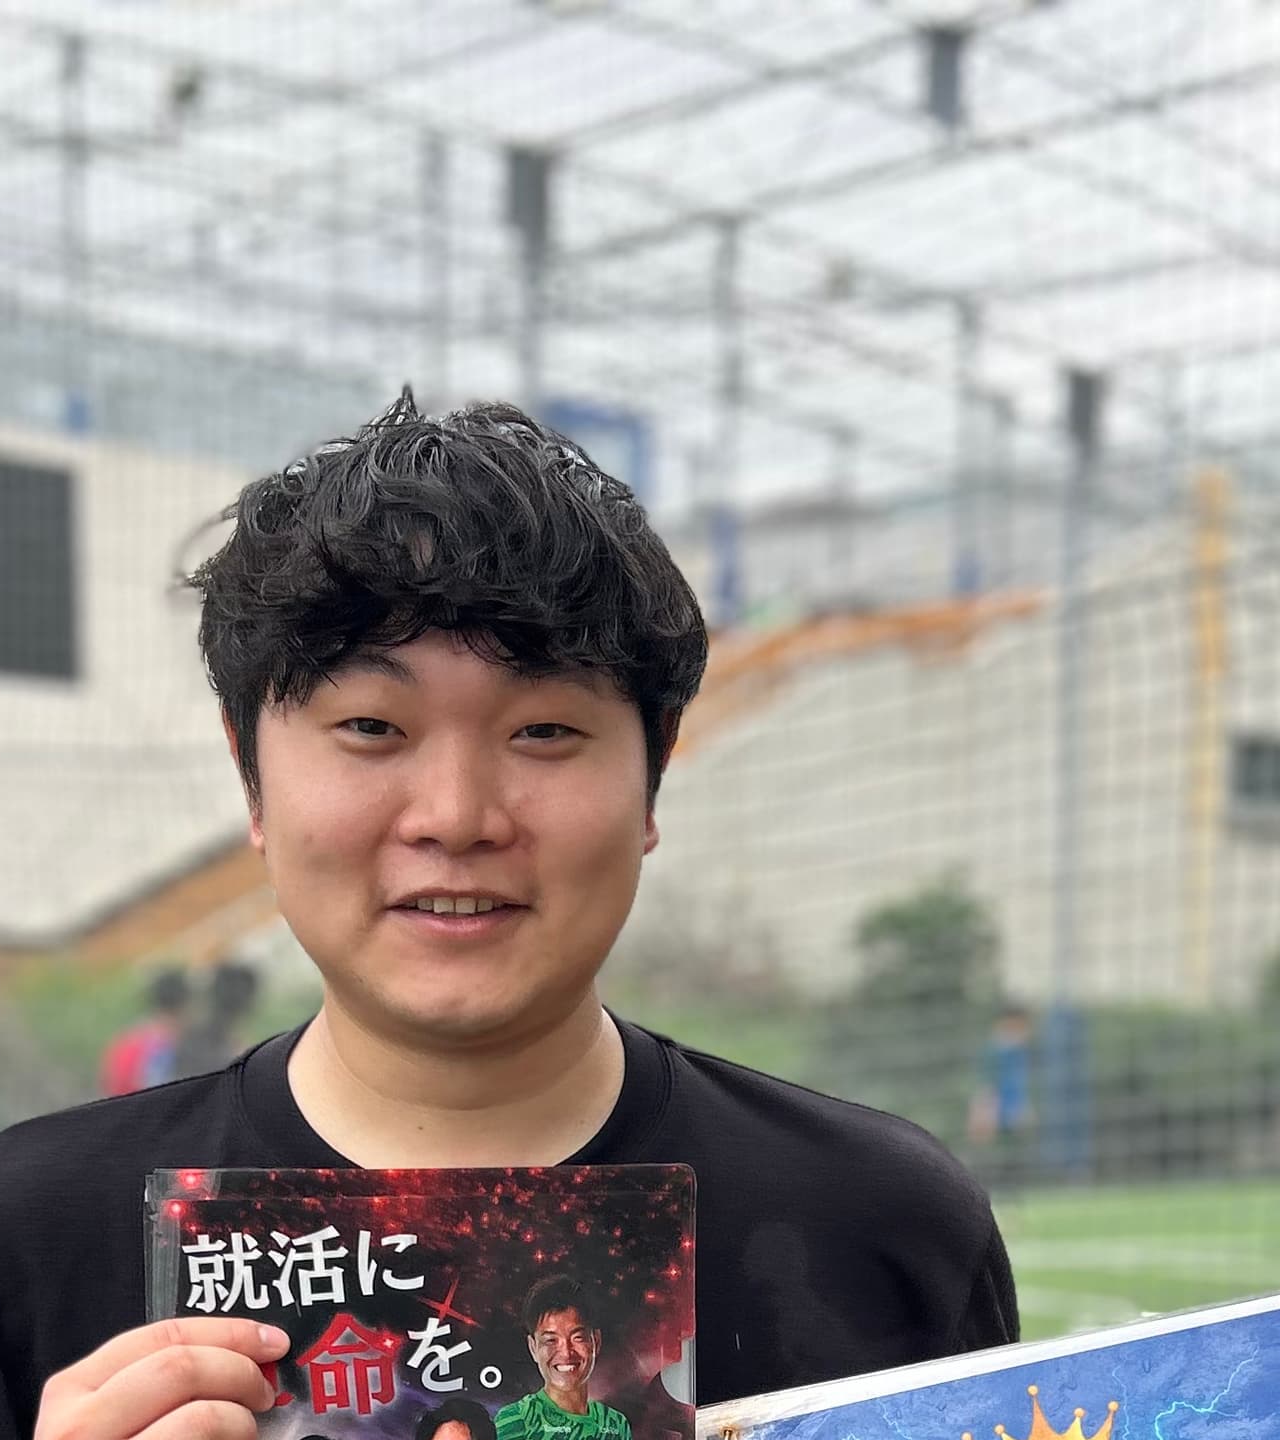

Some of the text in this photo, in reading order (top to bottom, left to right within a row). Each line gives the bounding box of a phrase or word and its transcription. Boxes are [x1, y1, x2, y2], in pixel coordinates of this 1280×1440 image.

[181, 1224, 425, 1313] 就活に
[260, 1312, 503, 1416] 命を。
